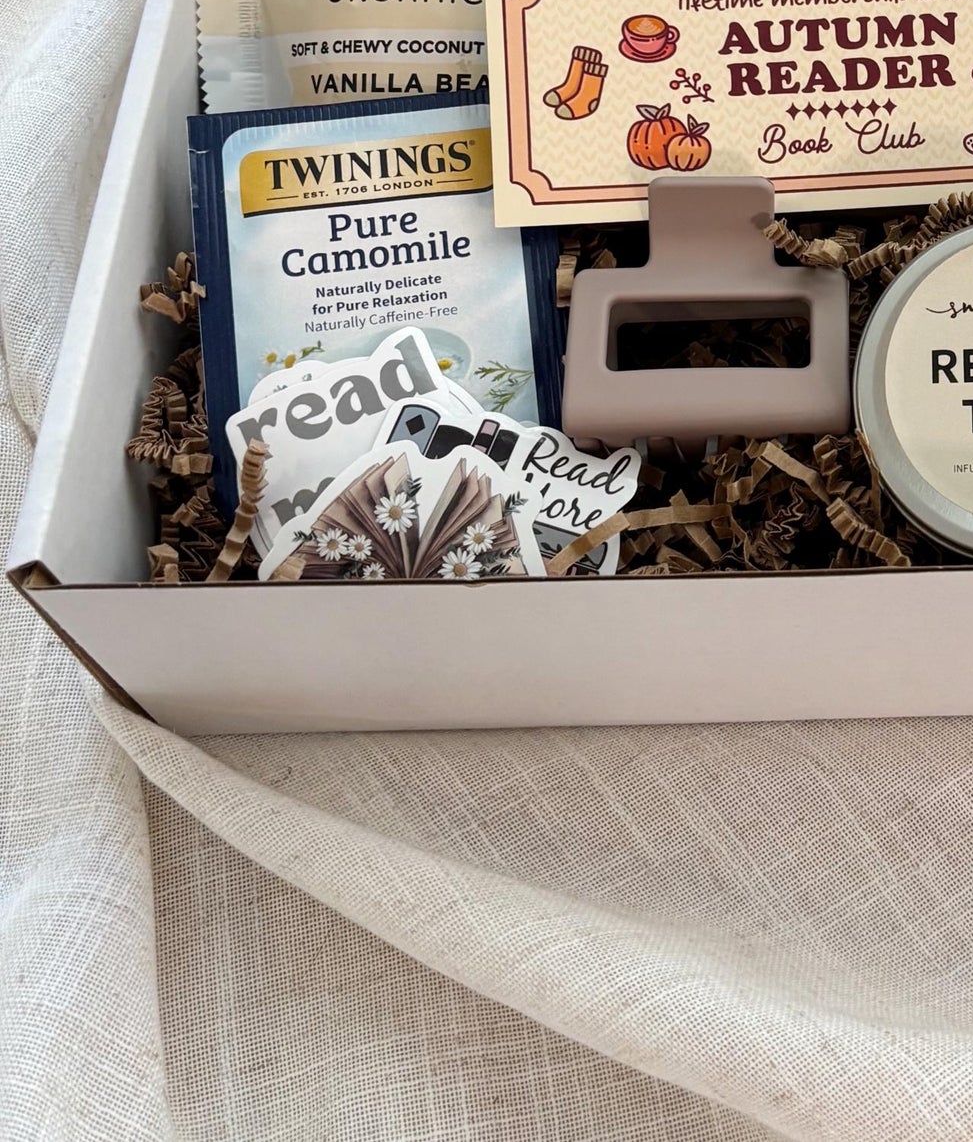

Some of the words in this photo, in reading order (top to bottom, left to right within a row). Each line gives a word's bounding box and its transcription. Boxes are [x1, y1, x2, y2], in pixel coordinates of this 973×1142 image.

[291, 41, 318, 57] SOFT
[320, 42, 329, 55] &
[332, 39, 393, 54] CHEWY
[396, 39, 486, 55] COCONUT
[718, 11, 958, 56] AUTUMN
[310, 73, 424, 95] VANILLA
[726, 53, 956, 97] READER
[757, 123, 834, 164] Book
[845, 118, 926, 155] Club
[303, 190, 329, 199] EST.
[335, 185, 368, 196] 1706
[373, 178, 433, 192] LONDON
[327, 211, 418, 242] Pure
[281, 230, 471, 277] Camomile
[315, 281, 382, 299] Naturally
[385, 274, 442, 291] Delicate
[312, 303, 333, 316] for
[336, 300, 369, 313] Pure
[372, 290, 448, 308] Relaxation
[304, 315, 367, 333] Naturally
[369, 306, 459, 326] Caffeine-Free
[236, 334, 439, 444] read
[521, 431, 632, 495] Read
